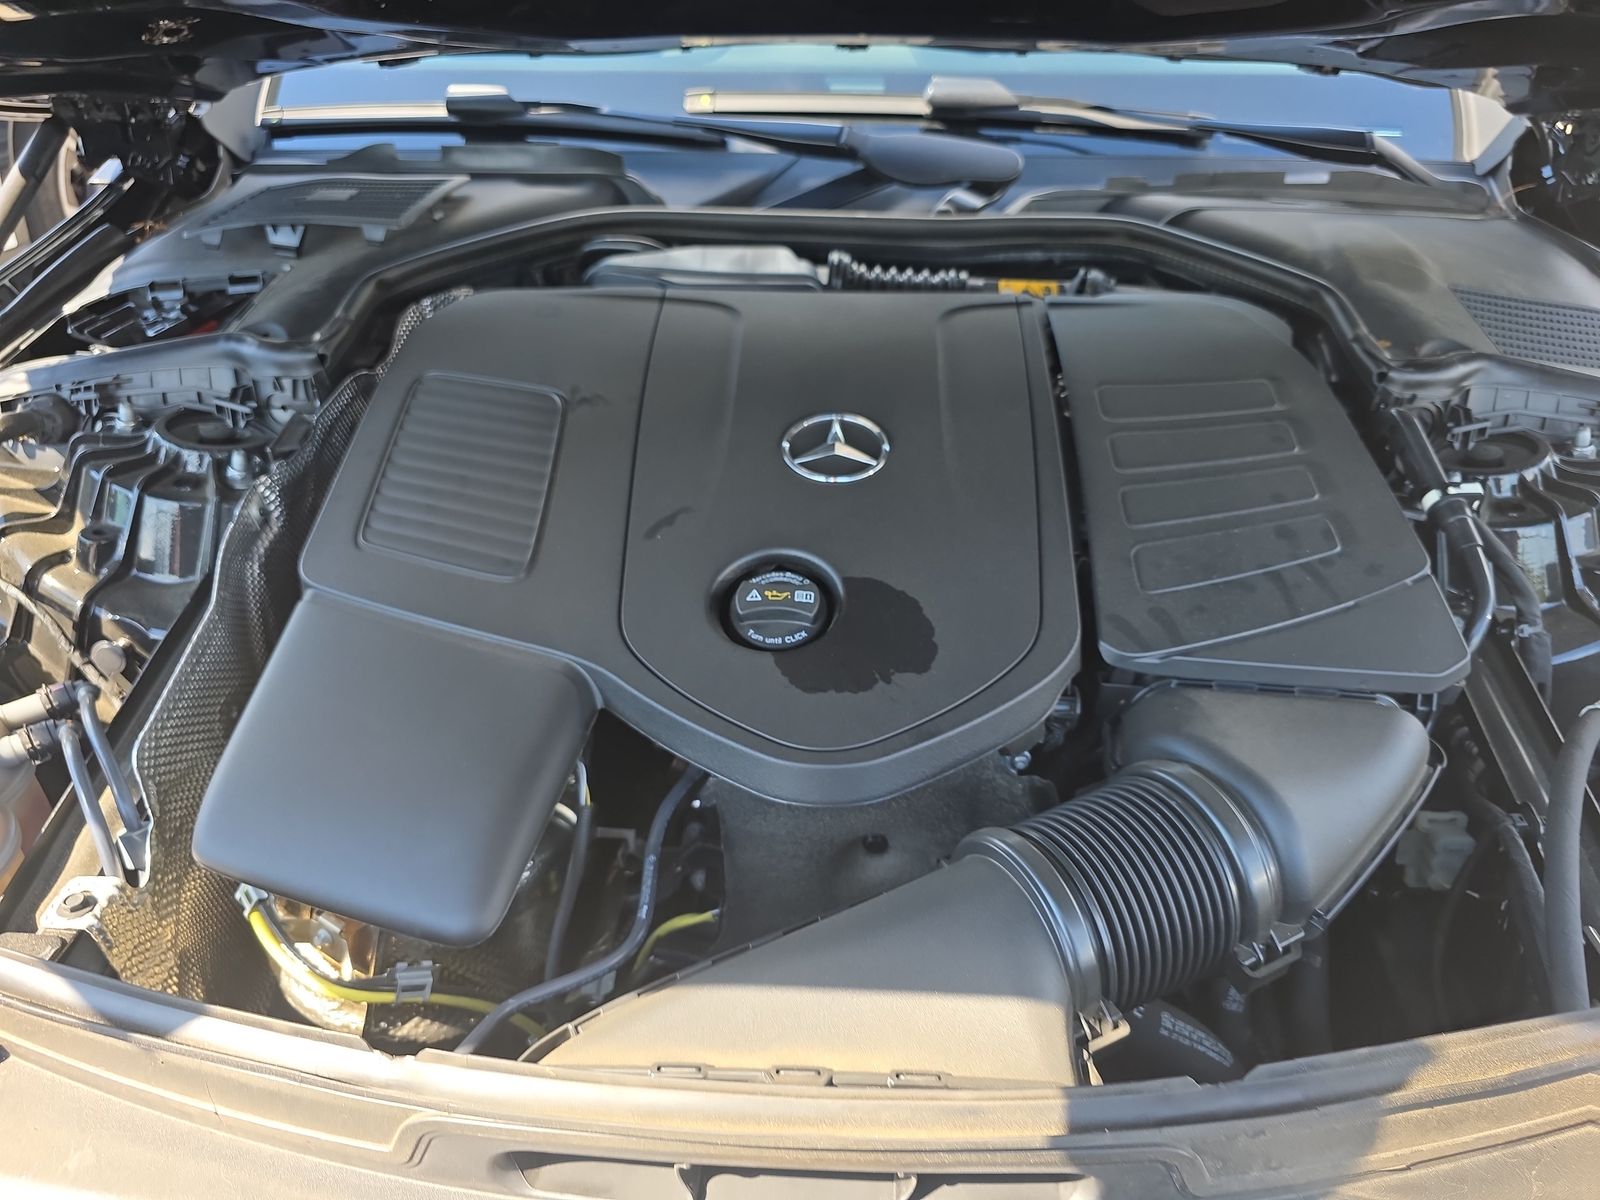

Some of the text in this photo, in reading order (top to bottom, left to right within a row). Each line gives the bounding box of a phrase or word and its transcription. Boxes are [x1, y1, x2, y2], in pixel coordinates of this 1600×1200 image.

[747, 628, 809, 645] Turn until CLICK
